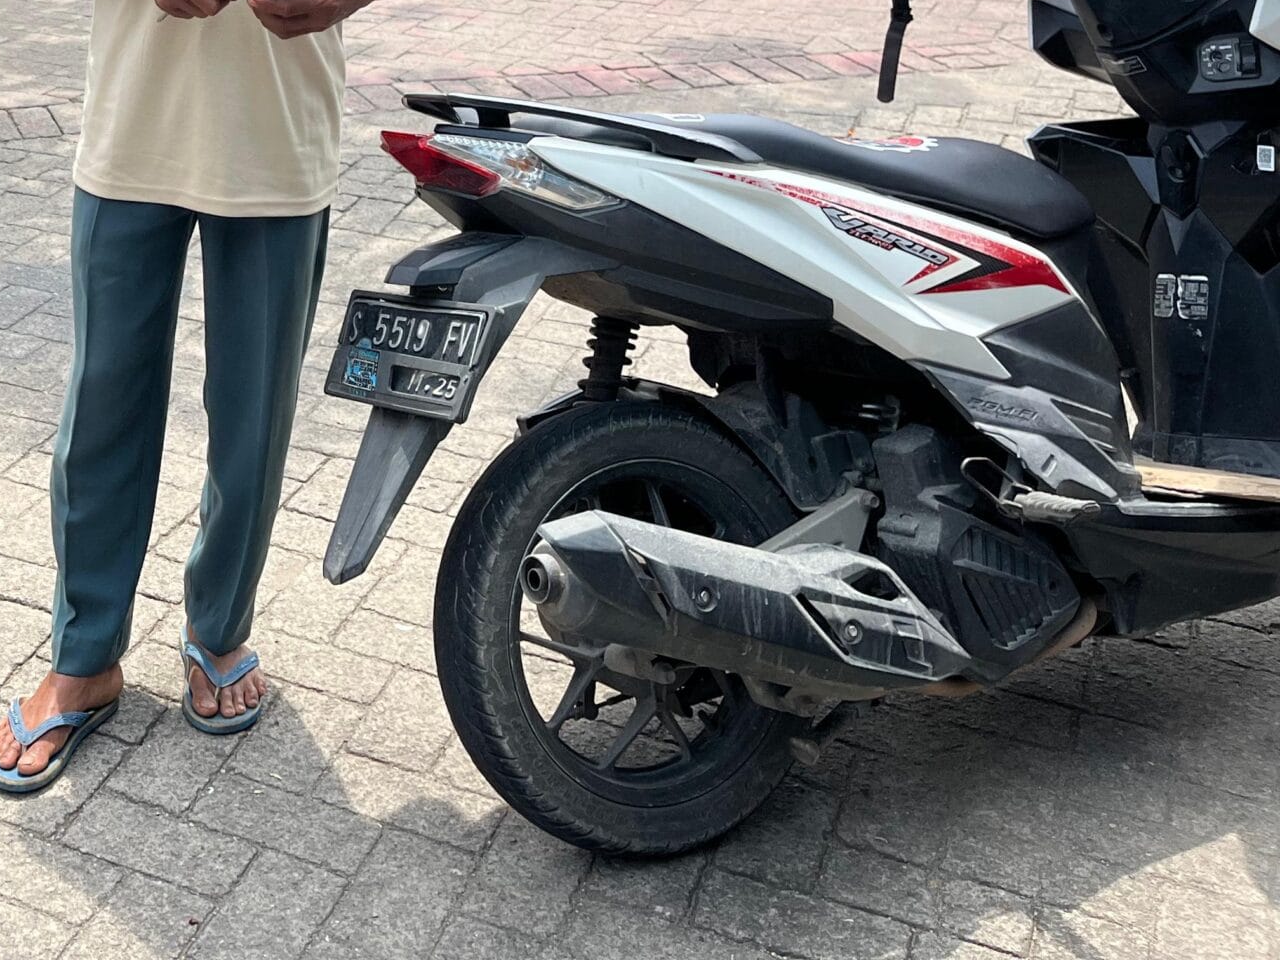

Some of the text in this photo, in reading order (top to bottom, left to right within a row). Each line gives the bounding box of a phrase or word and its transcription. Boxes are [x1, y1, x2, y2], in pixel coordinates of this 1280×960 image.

[821, 207, 950, 266] VARIO
[349, 310, 476, 360] S 5519 FV
